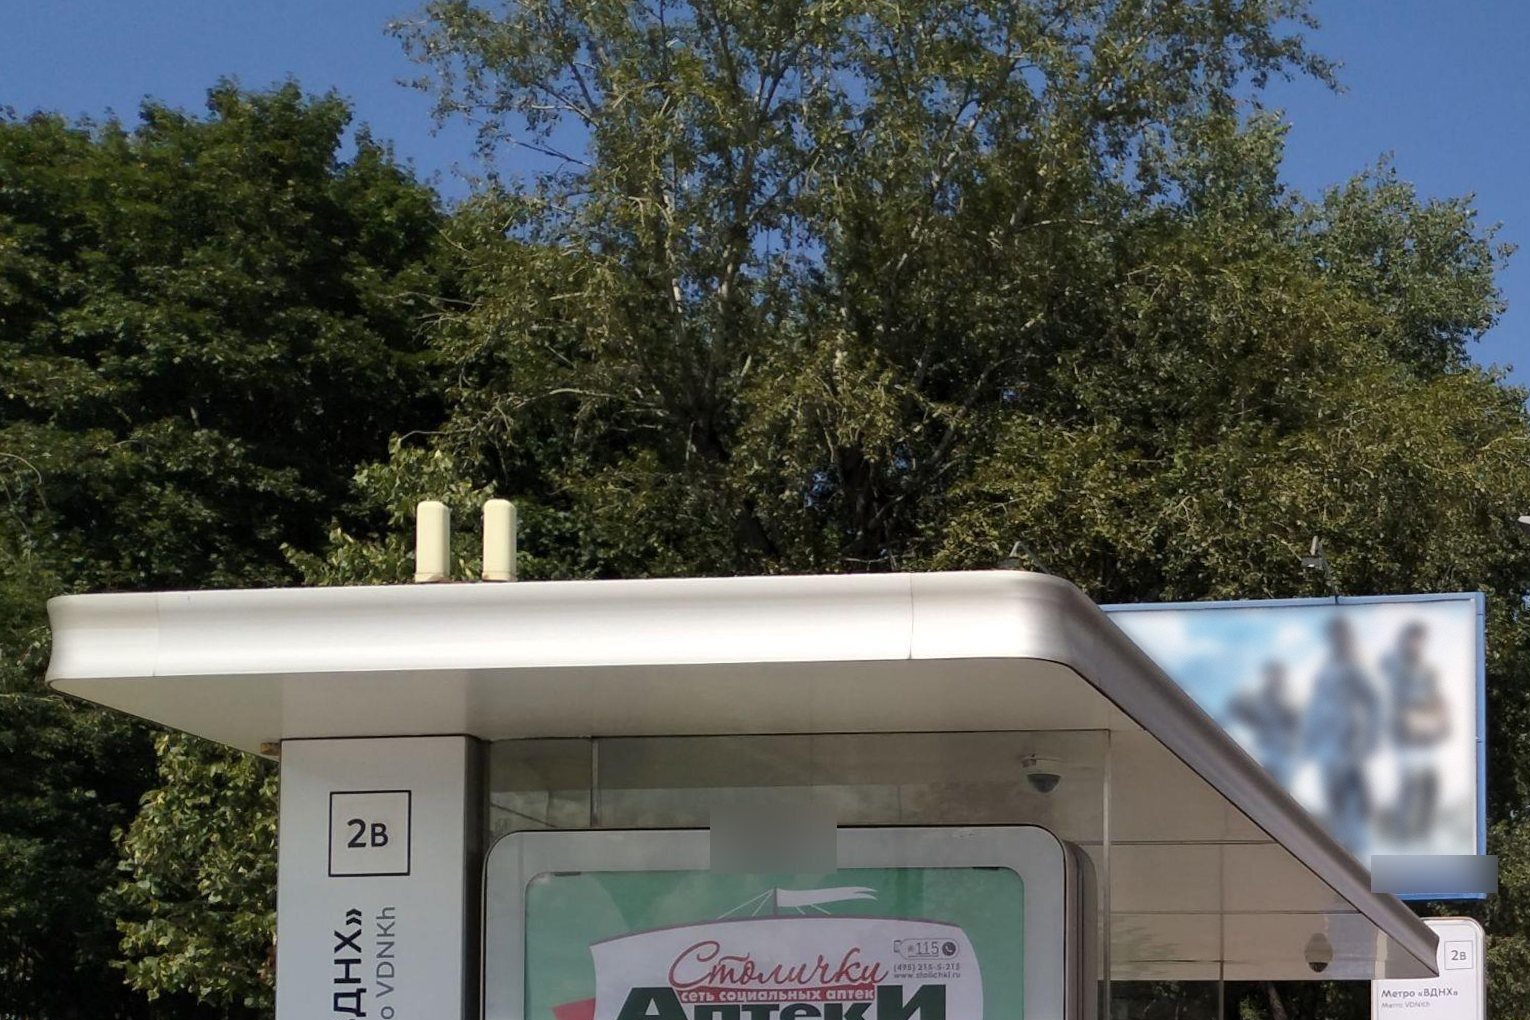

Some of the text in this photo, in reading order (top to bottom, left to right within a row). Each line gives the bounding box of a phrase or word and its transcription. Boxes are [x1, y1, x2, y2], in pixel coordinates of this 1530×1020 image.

[375, 906, 396, 996] VDNKh
[668, 940, 889, 989] Столички
[681, 989, 874, 1003] сеть социальных аптек
[1381, 990, 1416, 999] Метро
